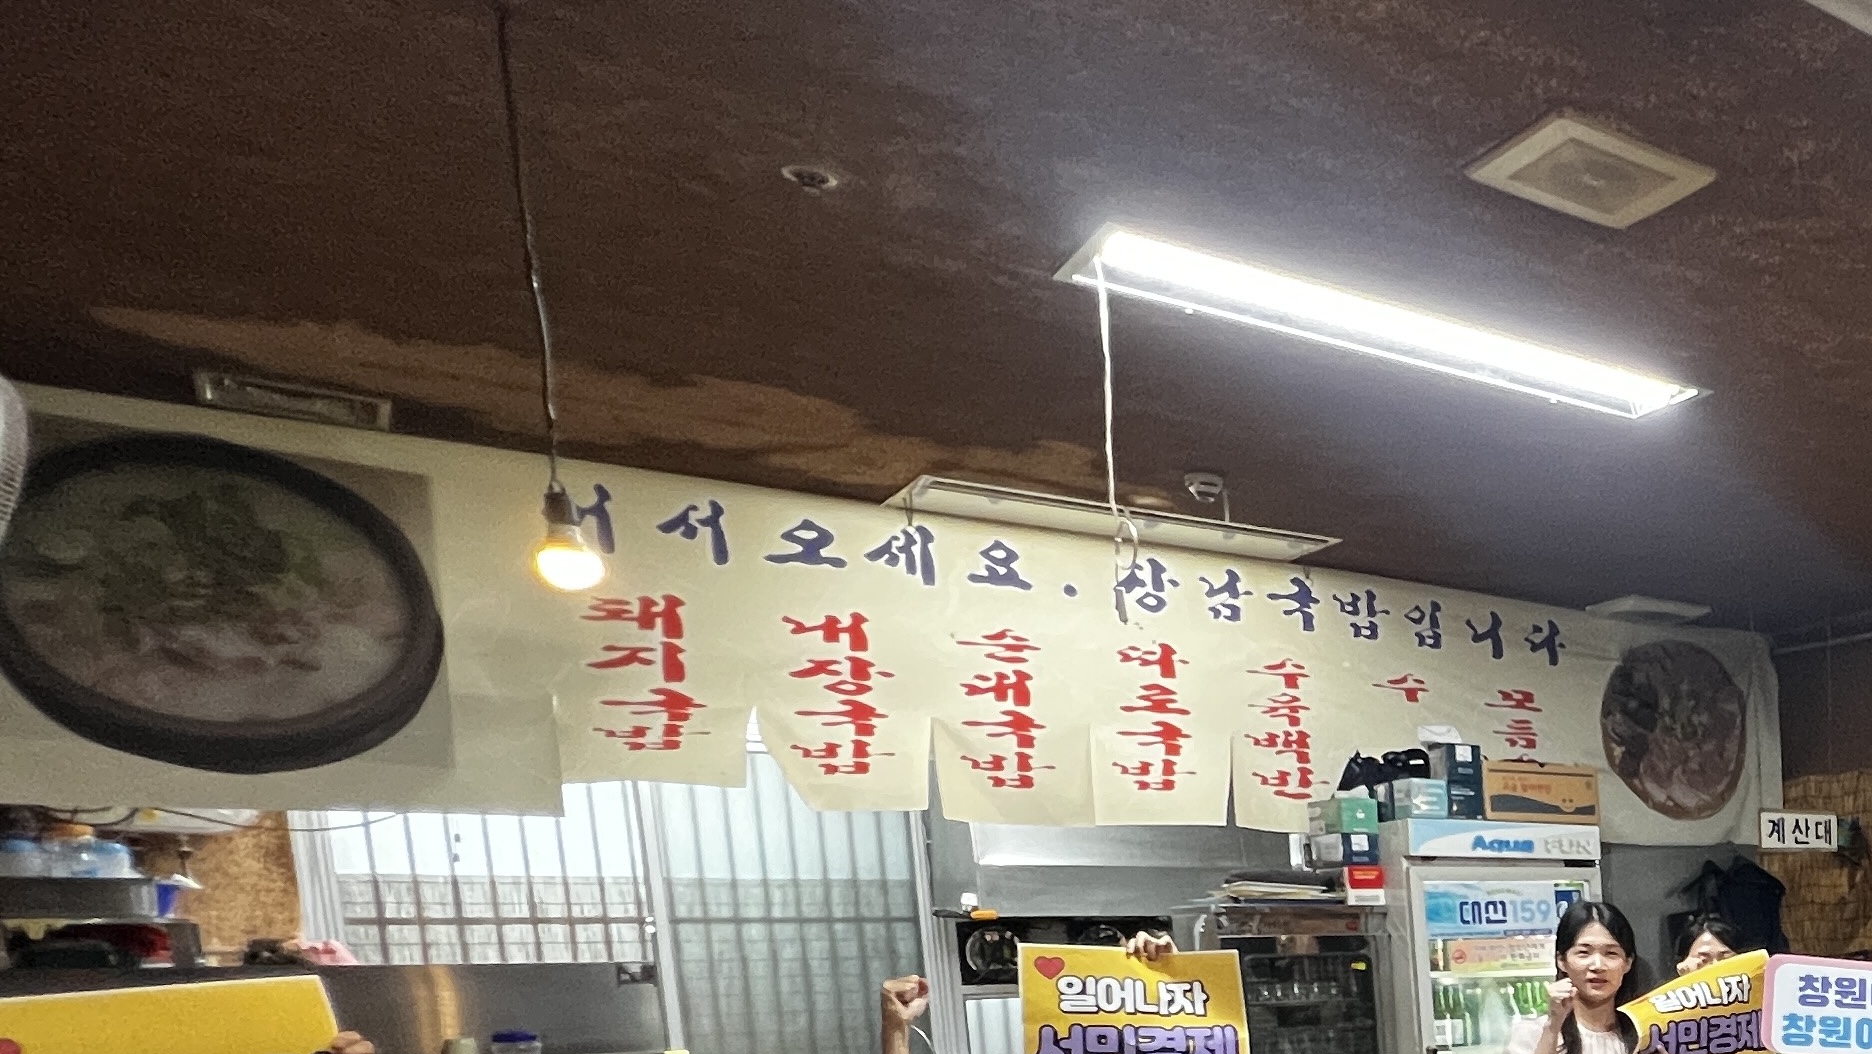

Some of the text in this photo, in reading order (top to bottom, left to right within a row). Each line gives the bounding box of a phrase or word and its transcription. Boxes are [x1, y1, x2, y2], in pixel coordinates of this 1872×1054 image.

[580, 595, 710, 751] 돼지국밥
[782, 612, 895, 775] 내장국밥
[955, 629, 1055, 789] 순대국밥
[1112, 642, 1196, 791] 따로국밥
[1484, 689, 1543, 762] 모듬
[1245, 658, 1330, 799] 수육백반
[1472, 835, 1535, 854] Aqua
[1766, 816, 1833, 843] 계산대
[1057, 975, 1209, 1017] 일어나자
[1648, 973, 1751, 1013] 일어나자
